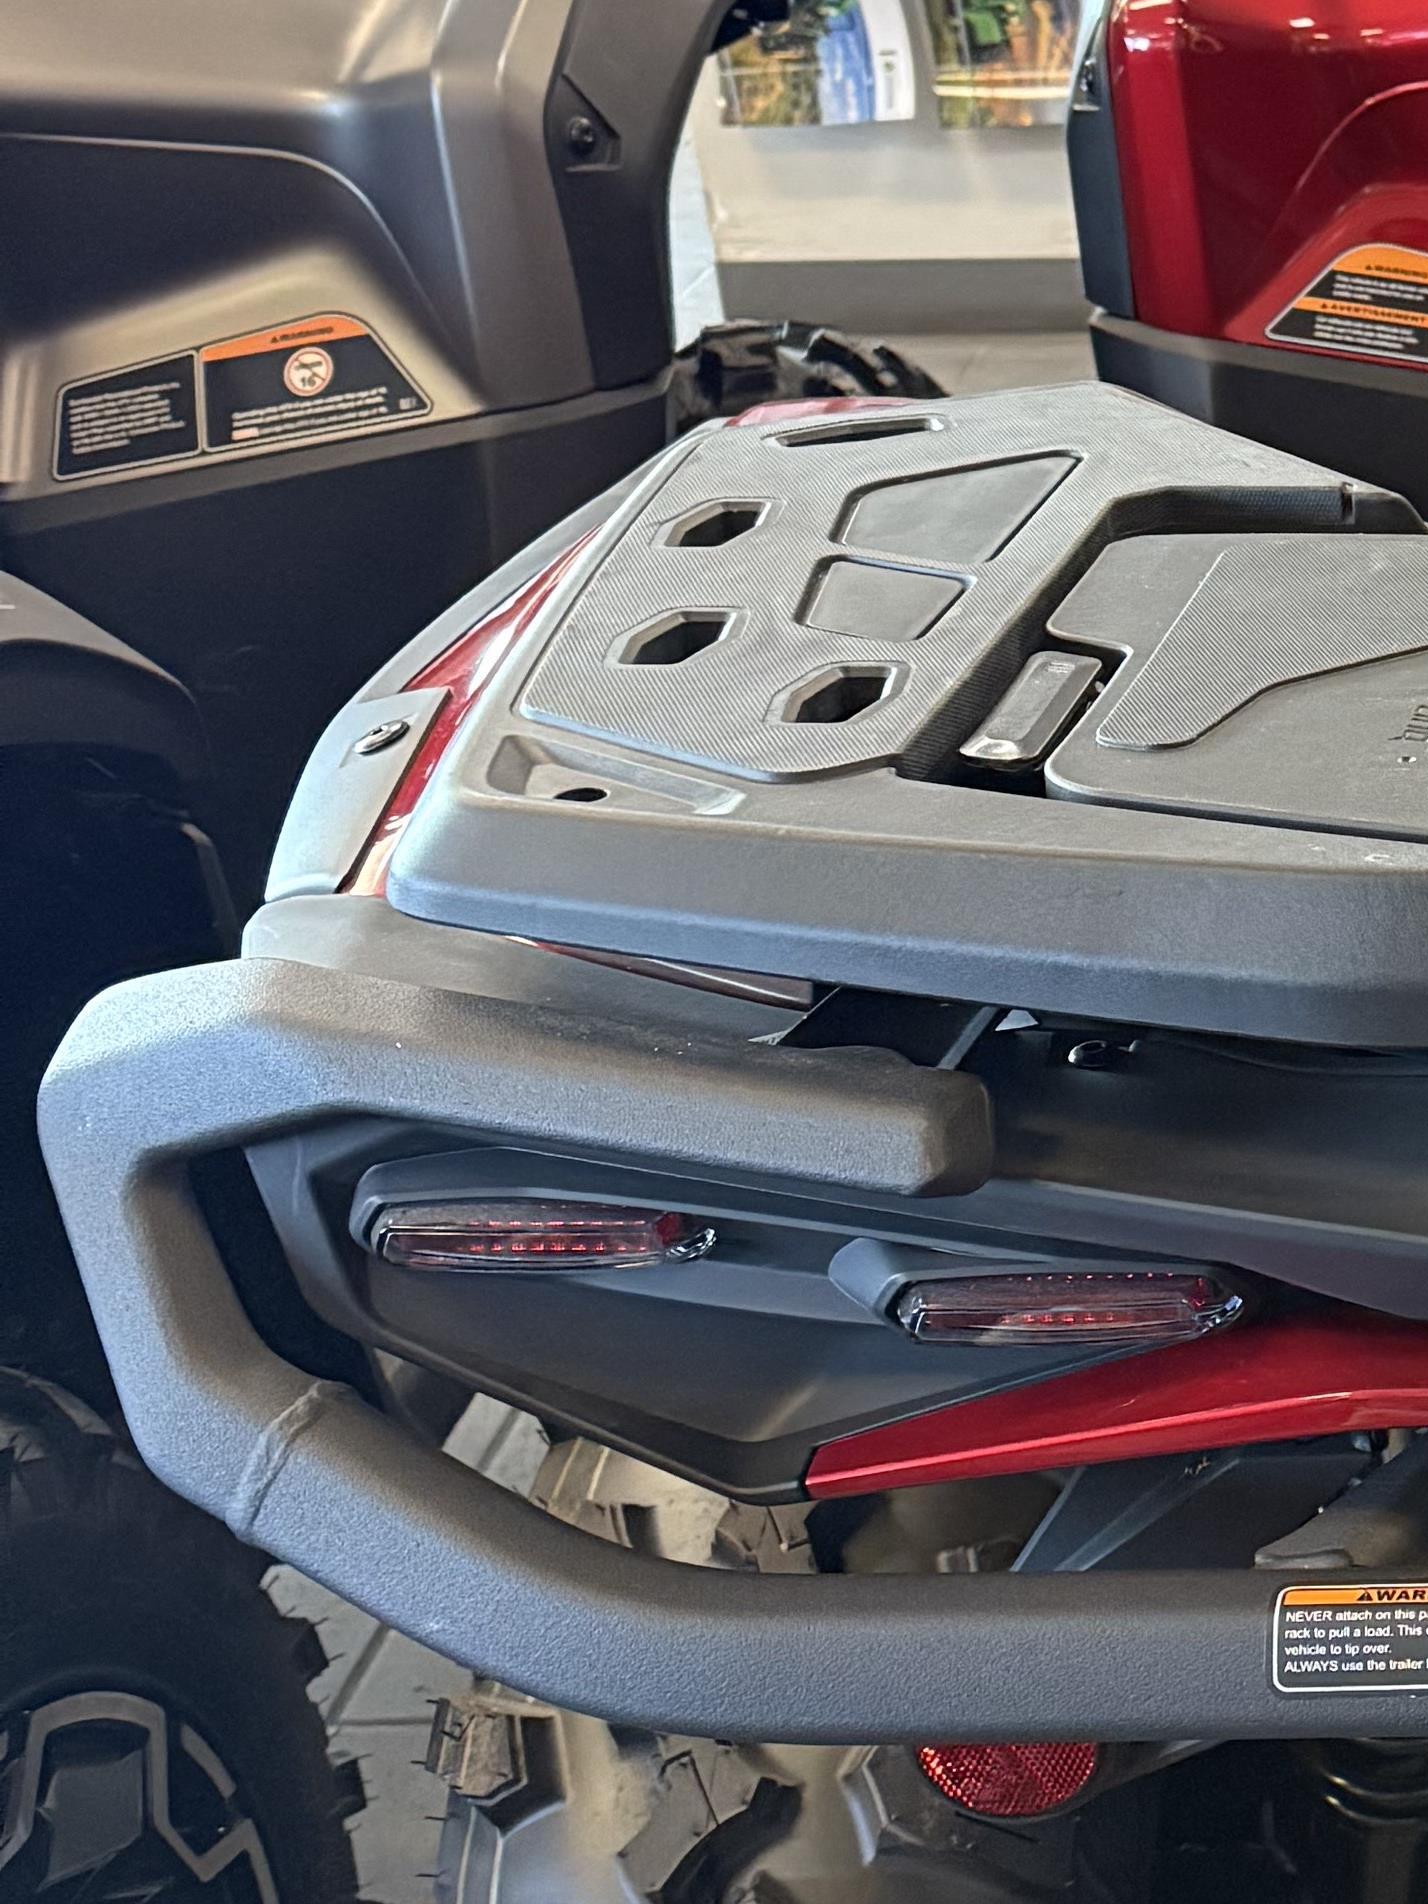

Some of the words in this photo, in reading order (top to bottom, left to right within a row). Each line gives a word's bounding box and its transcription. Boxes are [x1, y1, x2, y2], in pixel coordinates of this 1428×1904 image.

[1374, 264, 1428, 279] WARNING
[1285, 1610, 1332, 1622] NEVER
[1335, 1610, 1372, 1621] attach
[1375, 1610, 1391, 1620] on
[1394, 1609, 1416, 1620] this
[1285, 1626, 1311, 1639] rack
[1314, 1627, 1326, 1638] to
[1329, 1626, 1350, 1640] pull
[1353, 1627, 1361, 1637] a
[1364, 1626, 1394, 1637] load.
[1397, 1624, 1423, 1636] This
[1284, 1644, 1326, 1656] vehicle
[1330, 1644, 1342, 1655] to
[1345, 1644, 1360, 1656] tip
[1362, 1644, 1392, 1654] over.
[1284, 1660, 1339, 1673] ALWAYS
[1341, 1661, 1363, 1671] use
[1367, 1659, 1386, 1671] the
[1389, 1658, 1424, 1670] trailer
